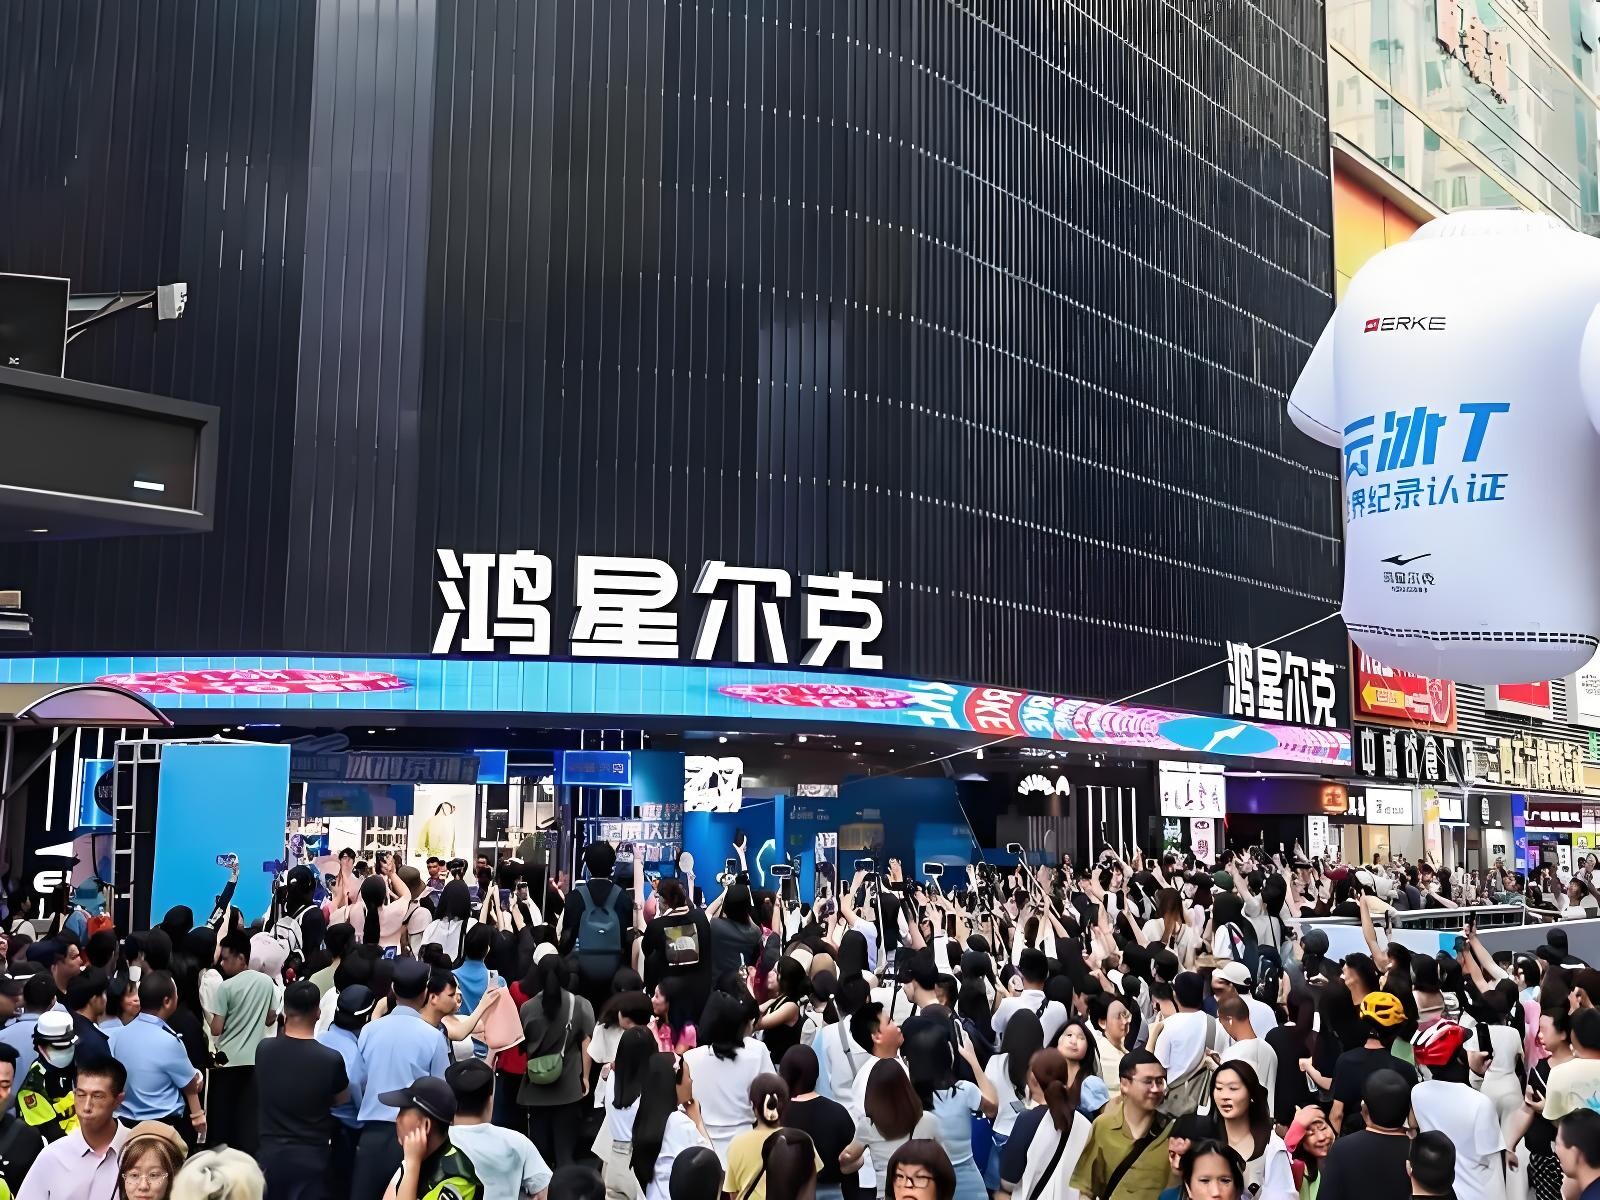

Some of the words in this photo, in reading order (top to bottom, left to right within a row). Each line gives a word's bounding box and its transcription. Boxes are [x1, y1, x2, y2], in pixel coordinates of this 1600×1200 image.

[1380, 316, 1447, 332] ERKE
[1346, 473, 1509, 523] 界纪录认证
[431, 548, 884, 670] 鸿星尔克
[1224, 640, 1337, 728] 鸿星尔克
